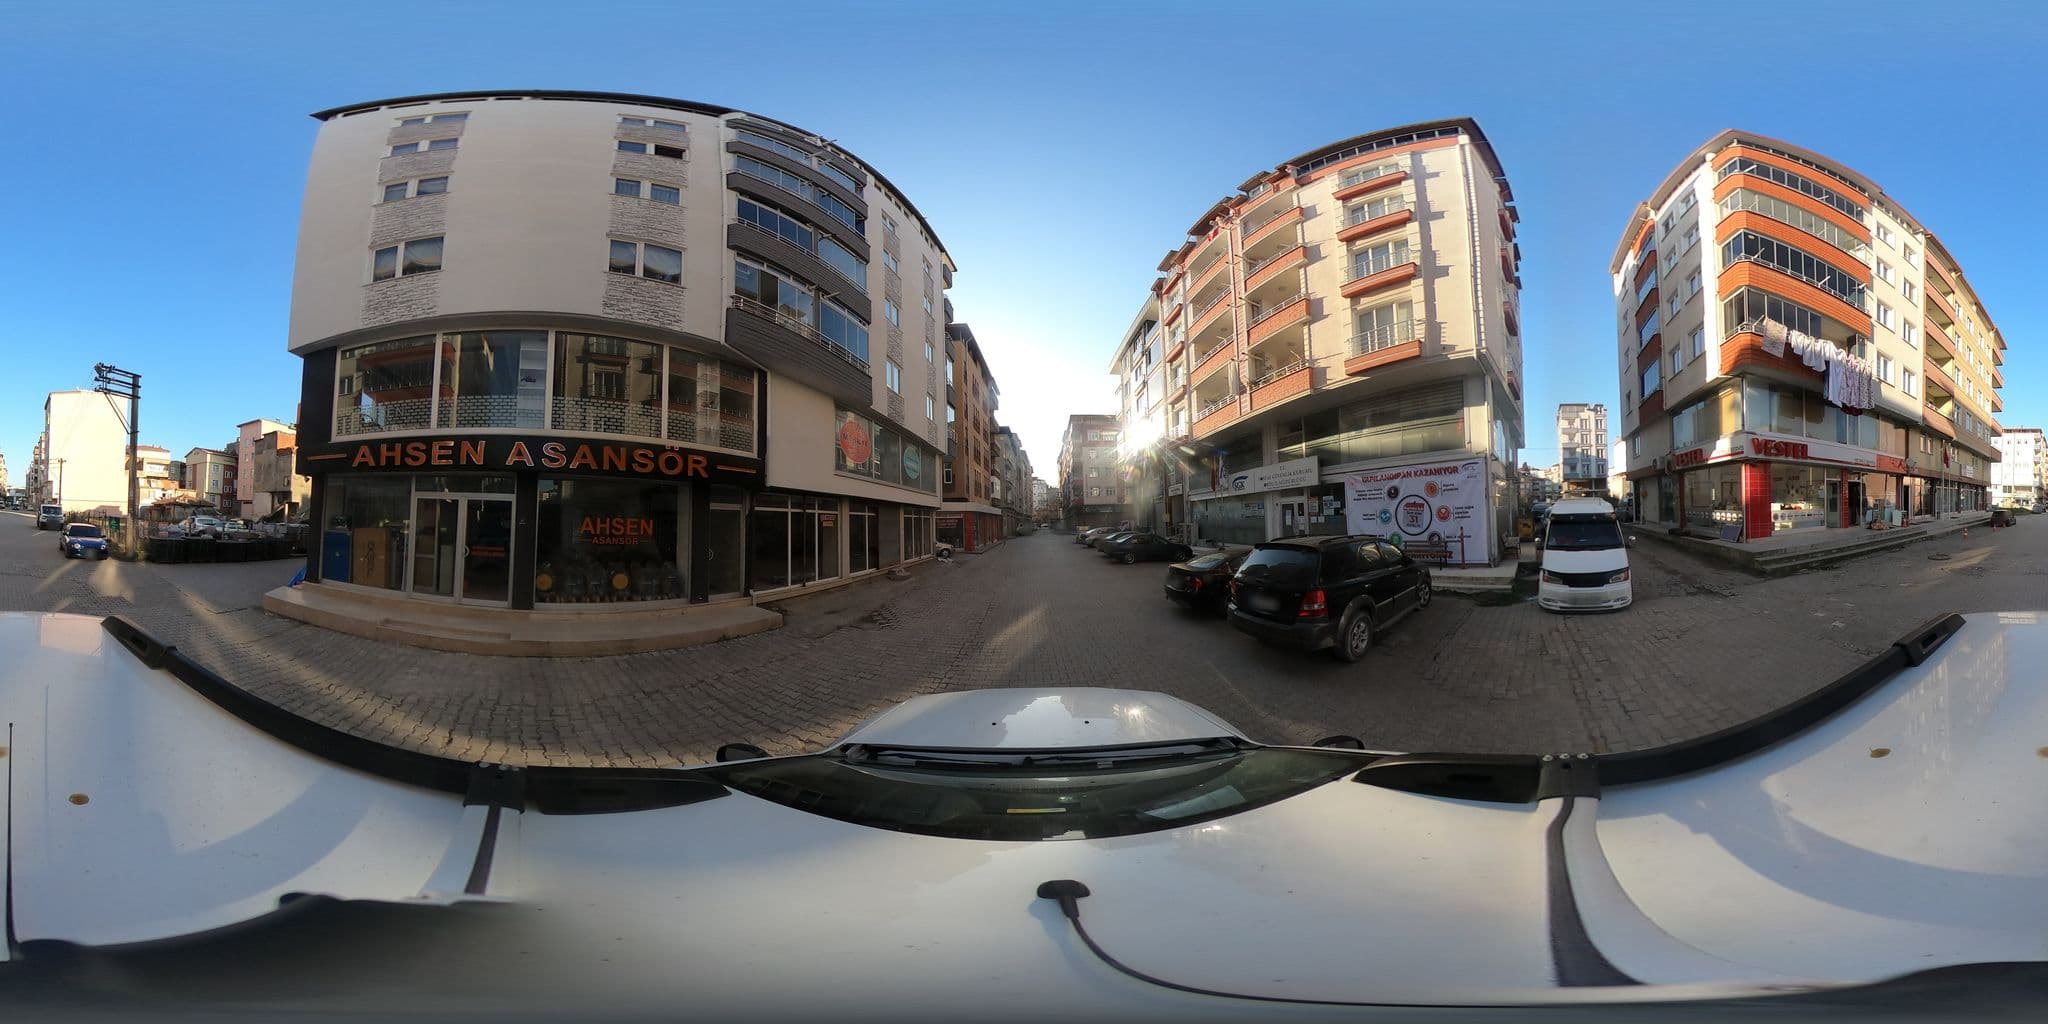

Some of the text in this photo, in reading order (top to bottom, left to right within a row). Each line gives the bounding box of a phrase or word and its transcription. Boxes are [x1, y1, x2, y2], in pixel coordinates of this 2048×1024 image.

[351, 440, 710, 479] AHSEN ASANSÖR
[1751, 437, 1809, 460] VESTEL
[579, 516, 654, 537] AHSEN
